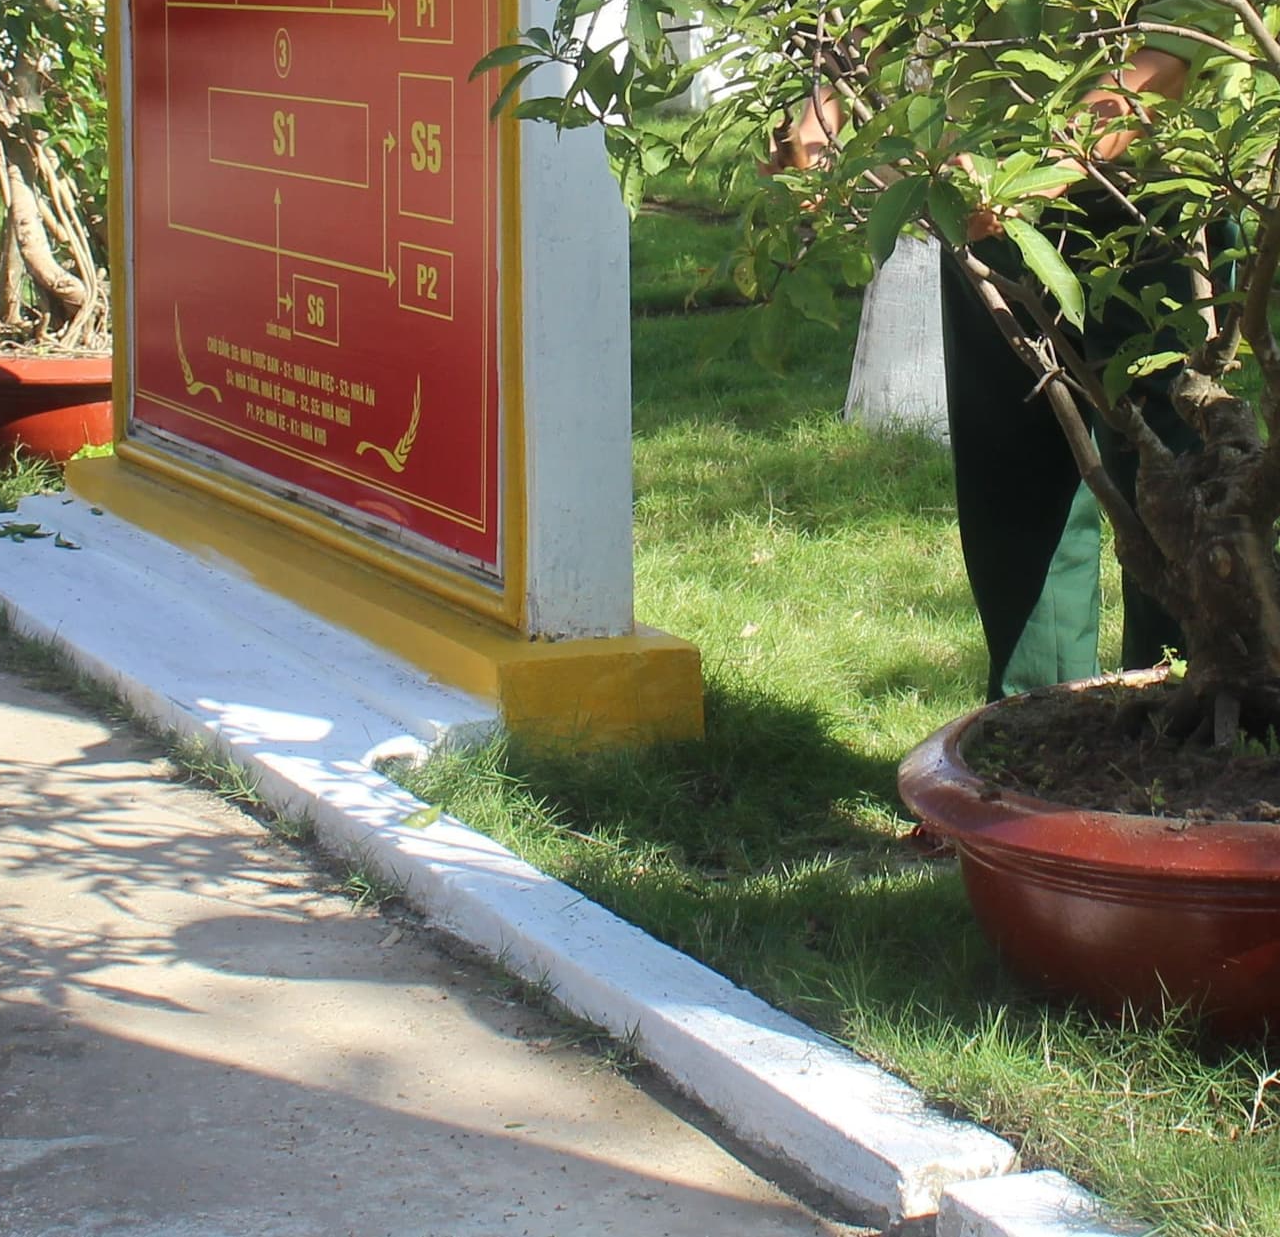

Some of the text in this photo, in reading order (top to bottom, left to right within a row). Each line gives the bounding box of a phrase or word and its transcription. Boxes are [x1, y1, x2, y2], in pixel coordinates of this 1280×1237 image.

[279, 39, 287, 67] 3
[273, 110, 296, 157] S1
[410, 121, 442, 173] S5
[416, 263, 438, 301] P2
[307, 296, 325, 328] S6
[350, 381, 364, 403] NHÀ
